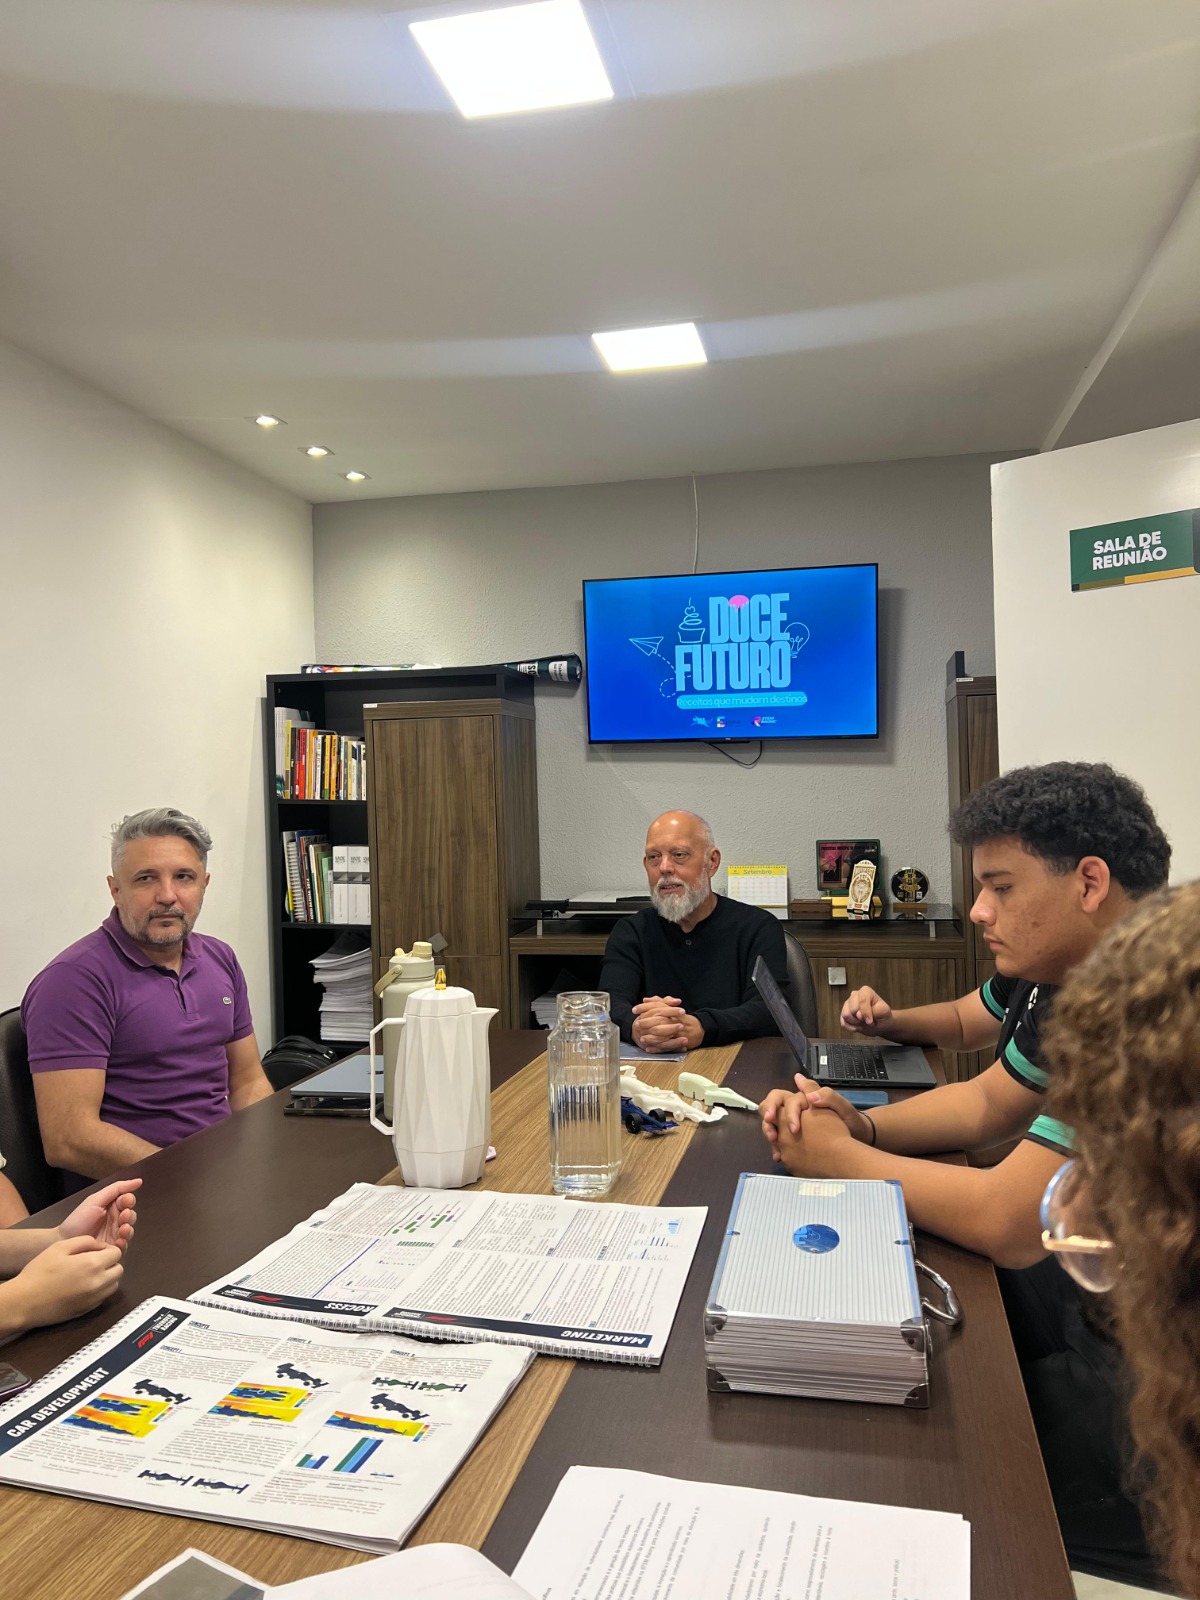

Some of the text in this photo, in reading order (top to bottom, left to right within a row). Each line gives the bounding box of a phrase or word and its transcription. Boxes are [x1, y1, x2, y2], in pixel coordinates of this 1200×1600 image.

[1093, 530, 1162, 555] SALA DE
[1092, 545, 1167, 570] REUNIÃO
[709, 592, 790, 644] DOCE
[675, 641, 791, 692] FUTURO
[677, 693, 808, 709] Receitas que mudam destinos
[560, 1329, 647, 1345] MARKETING
[6, 1419, 38, 1438] CAR
[31, 1367, 110, 1421] DEVELOPMENT
